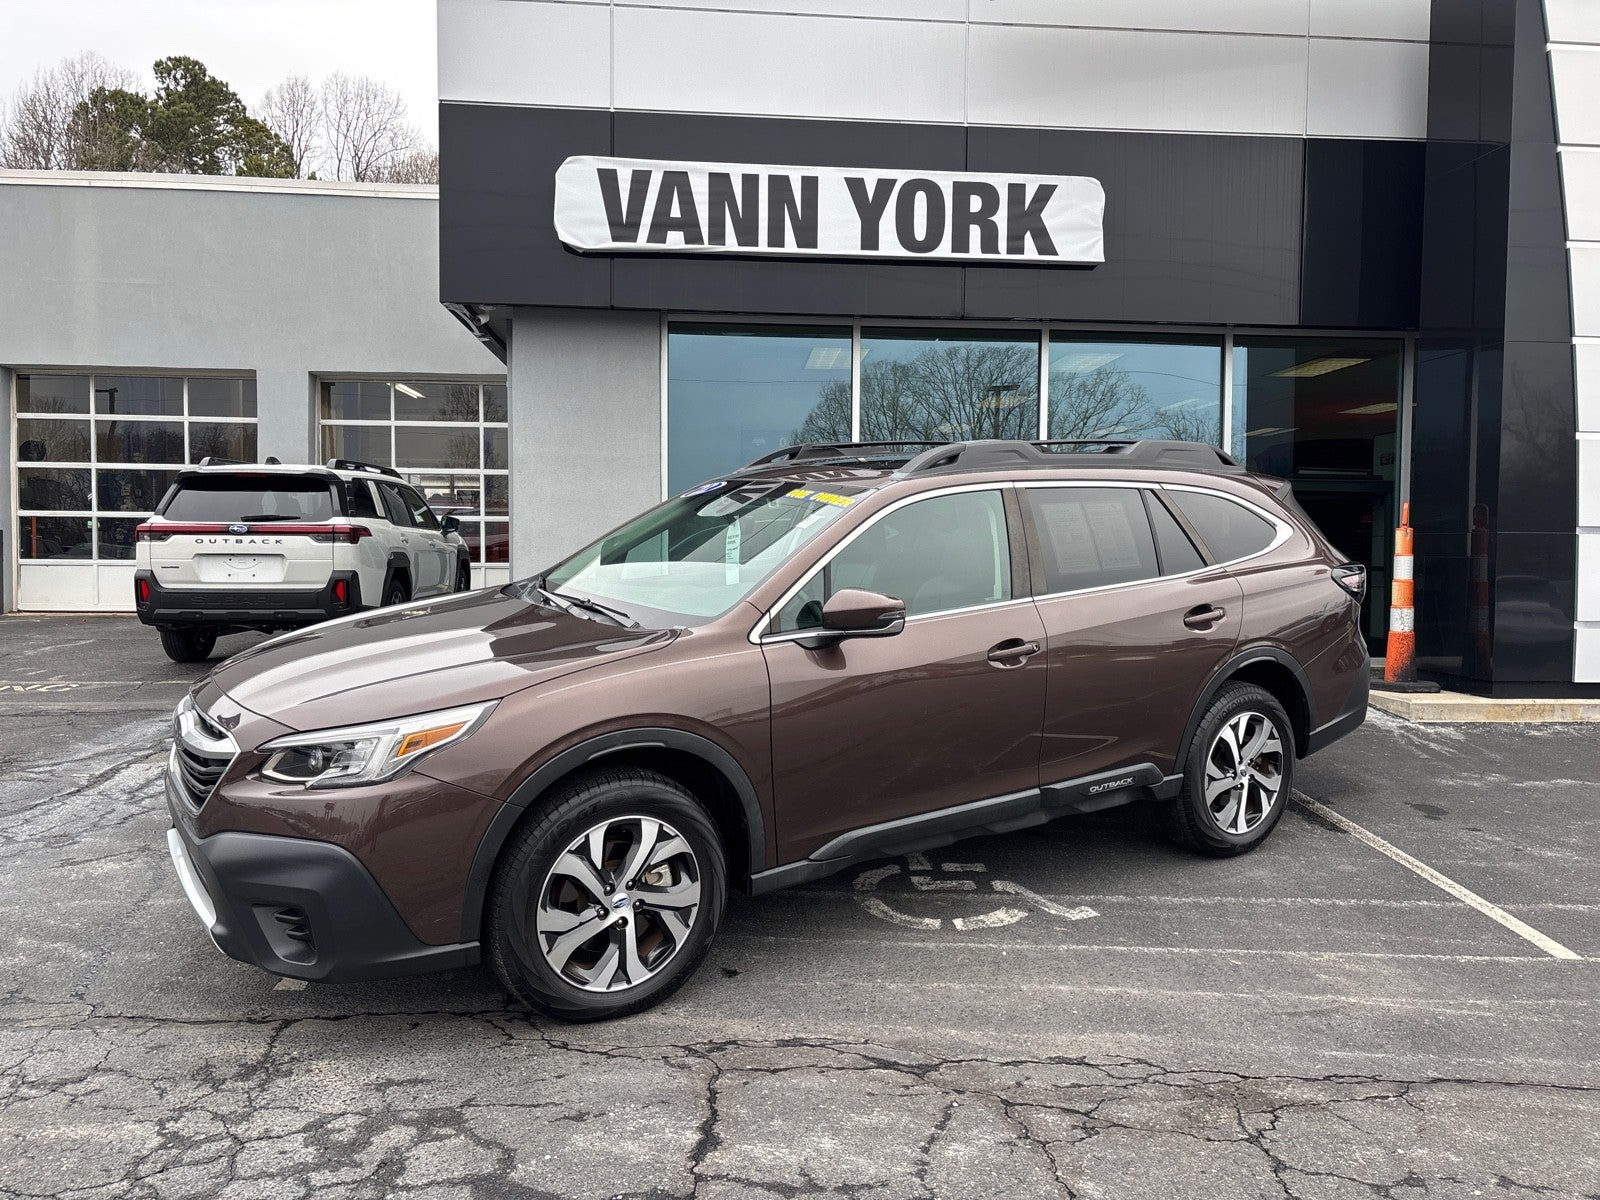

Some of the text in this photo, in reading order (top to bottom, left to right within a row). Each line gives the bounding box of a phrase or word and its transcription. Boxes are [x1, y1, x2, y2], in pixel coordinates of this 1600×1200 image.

[596, 168, 1059, 256] VANN YORK
[785, 489, 814, 499] ONE
[1089, 776, 1134, 793] OUTBACK
